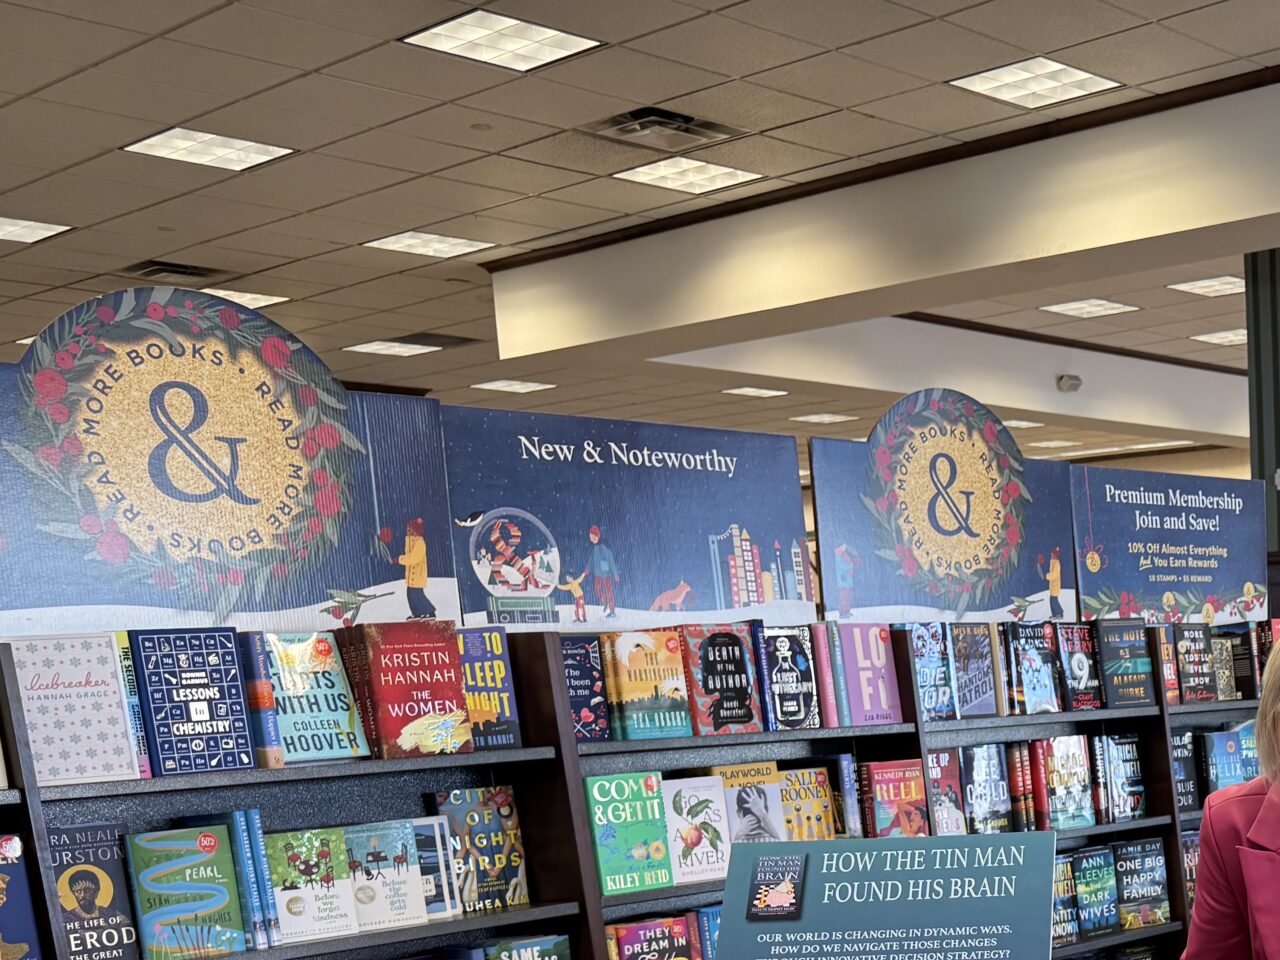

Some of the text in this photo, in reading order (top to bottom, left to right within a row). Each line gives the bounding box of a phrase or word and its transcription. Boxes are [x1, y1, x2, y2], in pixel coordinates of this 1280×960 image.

[83, 343, 224, 522] READ MORE BOOKS
[517, 435, 738, 477] New & Noteworthy
[169, 381, 304, 552] READ MORE BOOKS
[1105, 484, 1243, 514] Premium Membership
[1135, 510, 1219, 531] Join and Save!
[1128, 543, 1227, 558] 10% Off Almost Everything
[1139, 556, 1218, 568] And You Earn Rewards
[380, 651, 451, 668] KRISTIN
[24, 671, 110, 691] Icebreaker
[380, 669, 456, 685] HANNAH
[27, 690, 110, 702] HANNAH GRACE
[172, 686, 220, 701] LESSONS
[411, 690, 431, 700] THE
[388, 700, 458, 717] WOMEN
[172, 719, 230, 736] CHEMISTRY
[293, 719, 341, 732] COLLEEN
[282, 730, 360, 753] HOOVER
[875, 781, 922, 801] REEL
[821, 845, 1025, 873] HOW THE TIN MAN
[1117, 856, 1164, 872] ONE BIG
[185, 864, 223, 880] PEARL
[1123, 871, 1161, 886] HAPPY
[822, 875, 1017, 903] FOUND HIS BRAIN
[1123, 885, 1163, 901] FAMILY
[757, 925, 1013, 942] OUR WORLD IS CHANGING IN DYNAMIC WAYS.
[771, 938, 997, 954] HOW DO WE NAVIGATE THOSE CHANGES
[947, 950, 1010, 960] STRATEGY?
